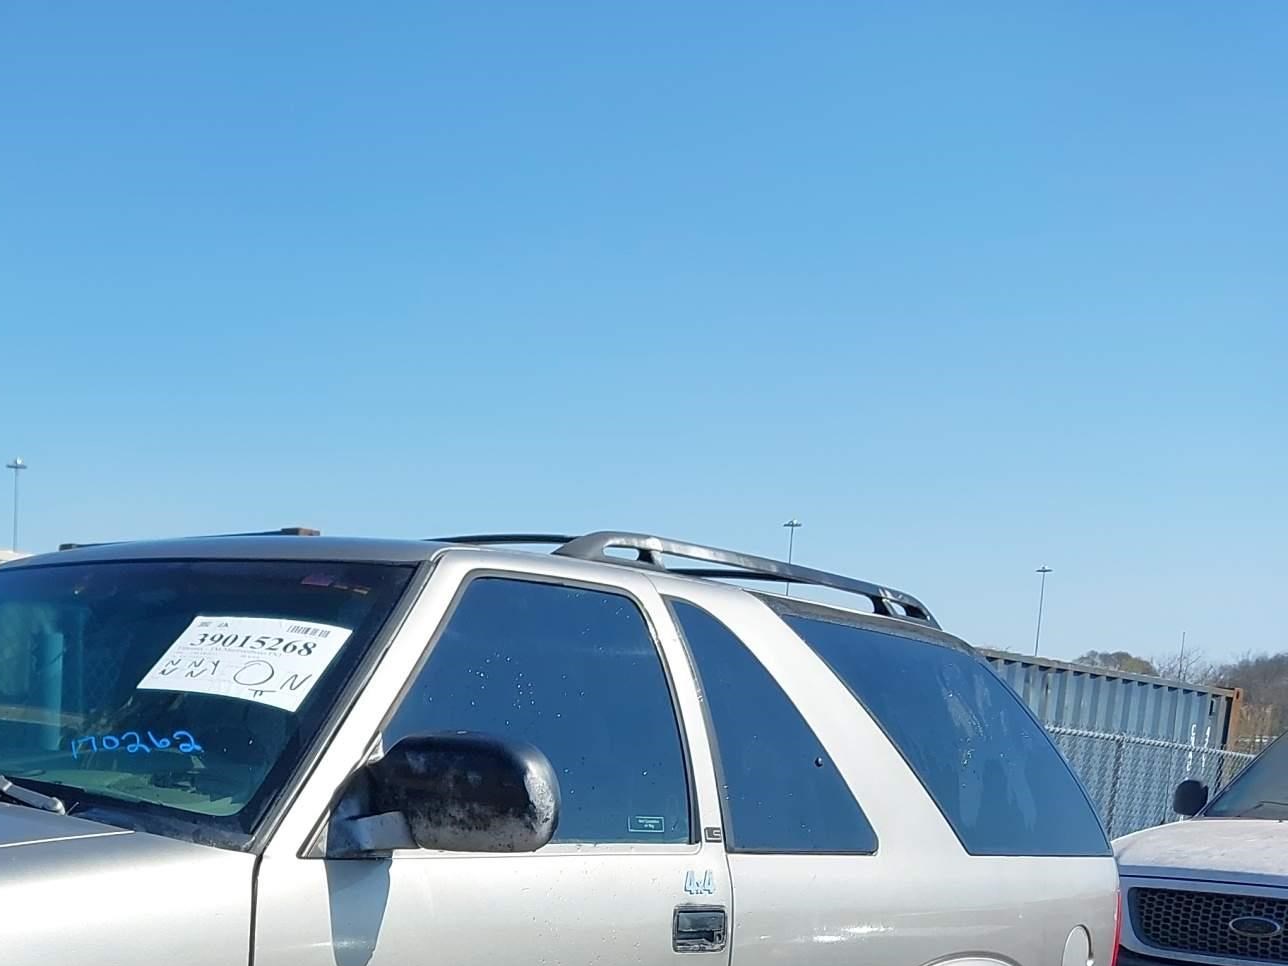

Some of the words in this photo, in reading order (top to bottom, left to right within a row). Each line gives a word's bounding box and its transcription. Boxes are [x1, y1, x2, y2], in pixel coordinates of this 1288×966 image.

[190, 632, 318, 657] 39015268
[71, 730, 204, 759] 170262
[684, 869, 715, 895] 4x4
